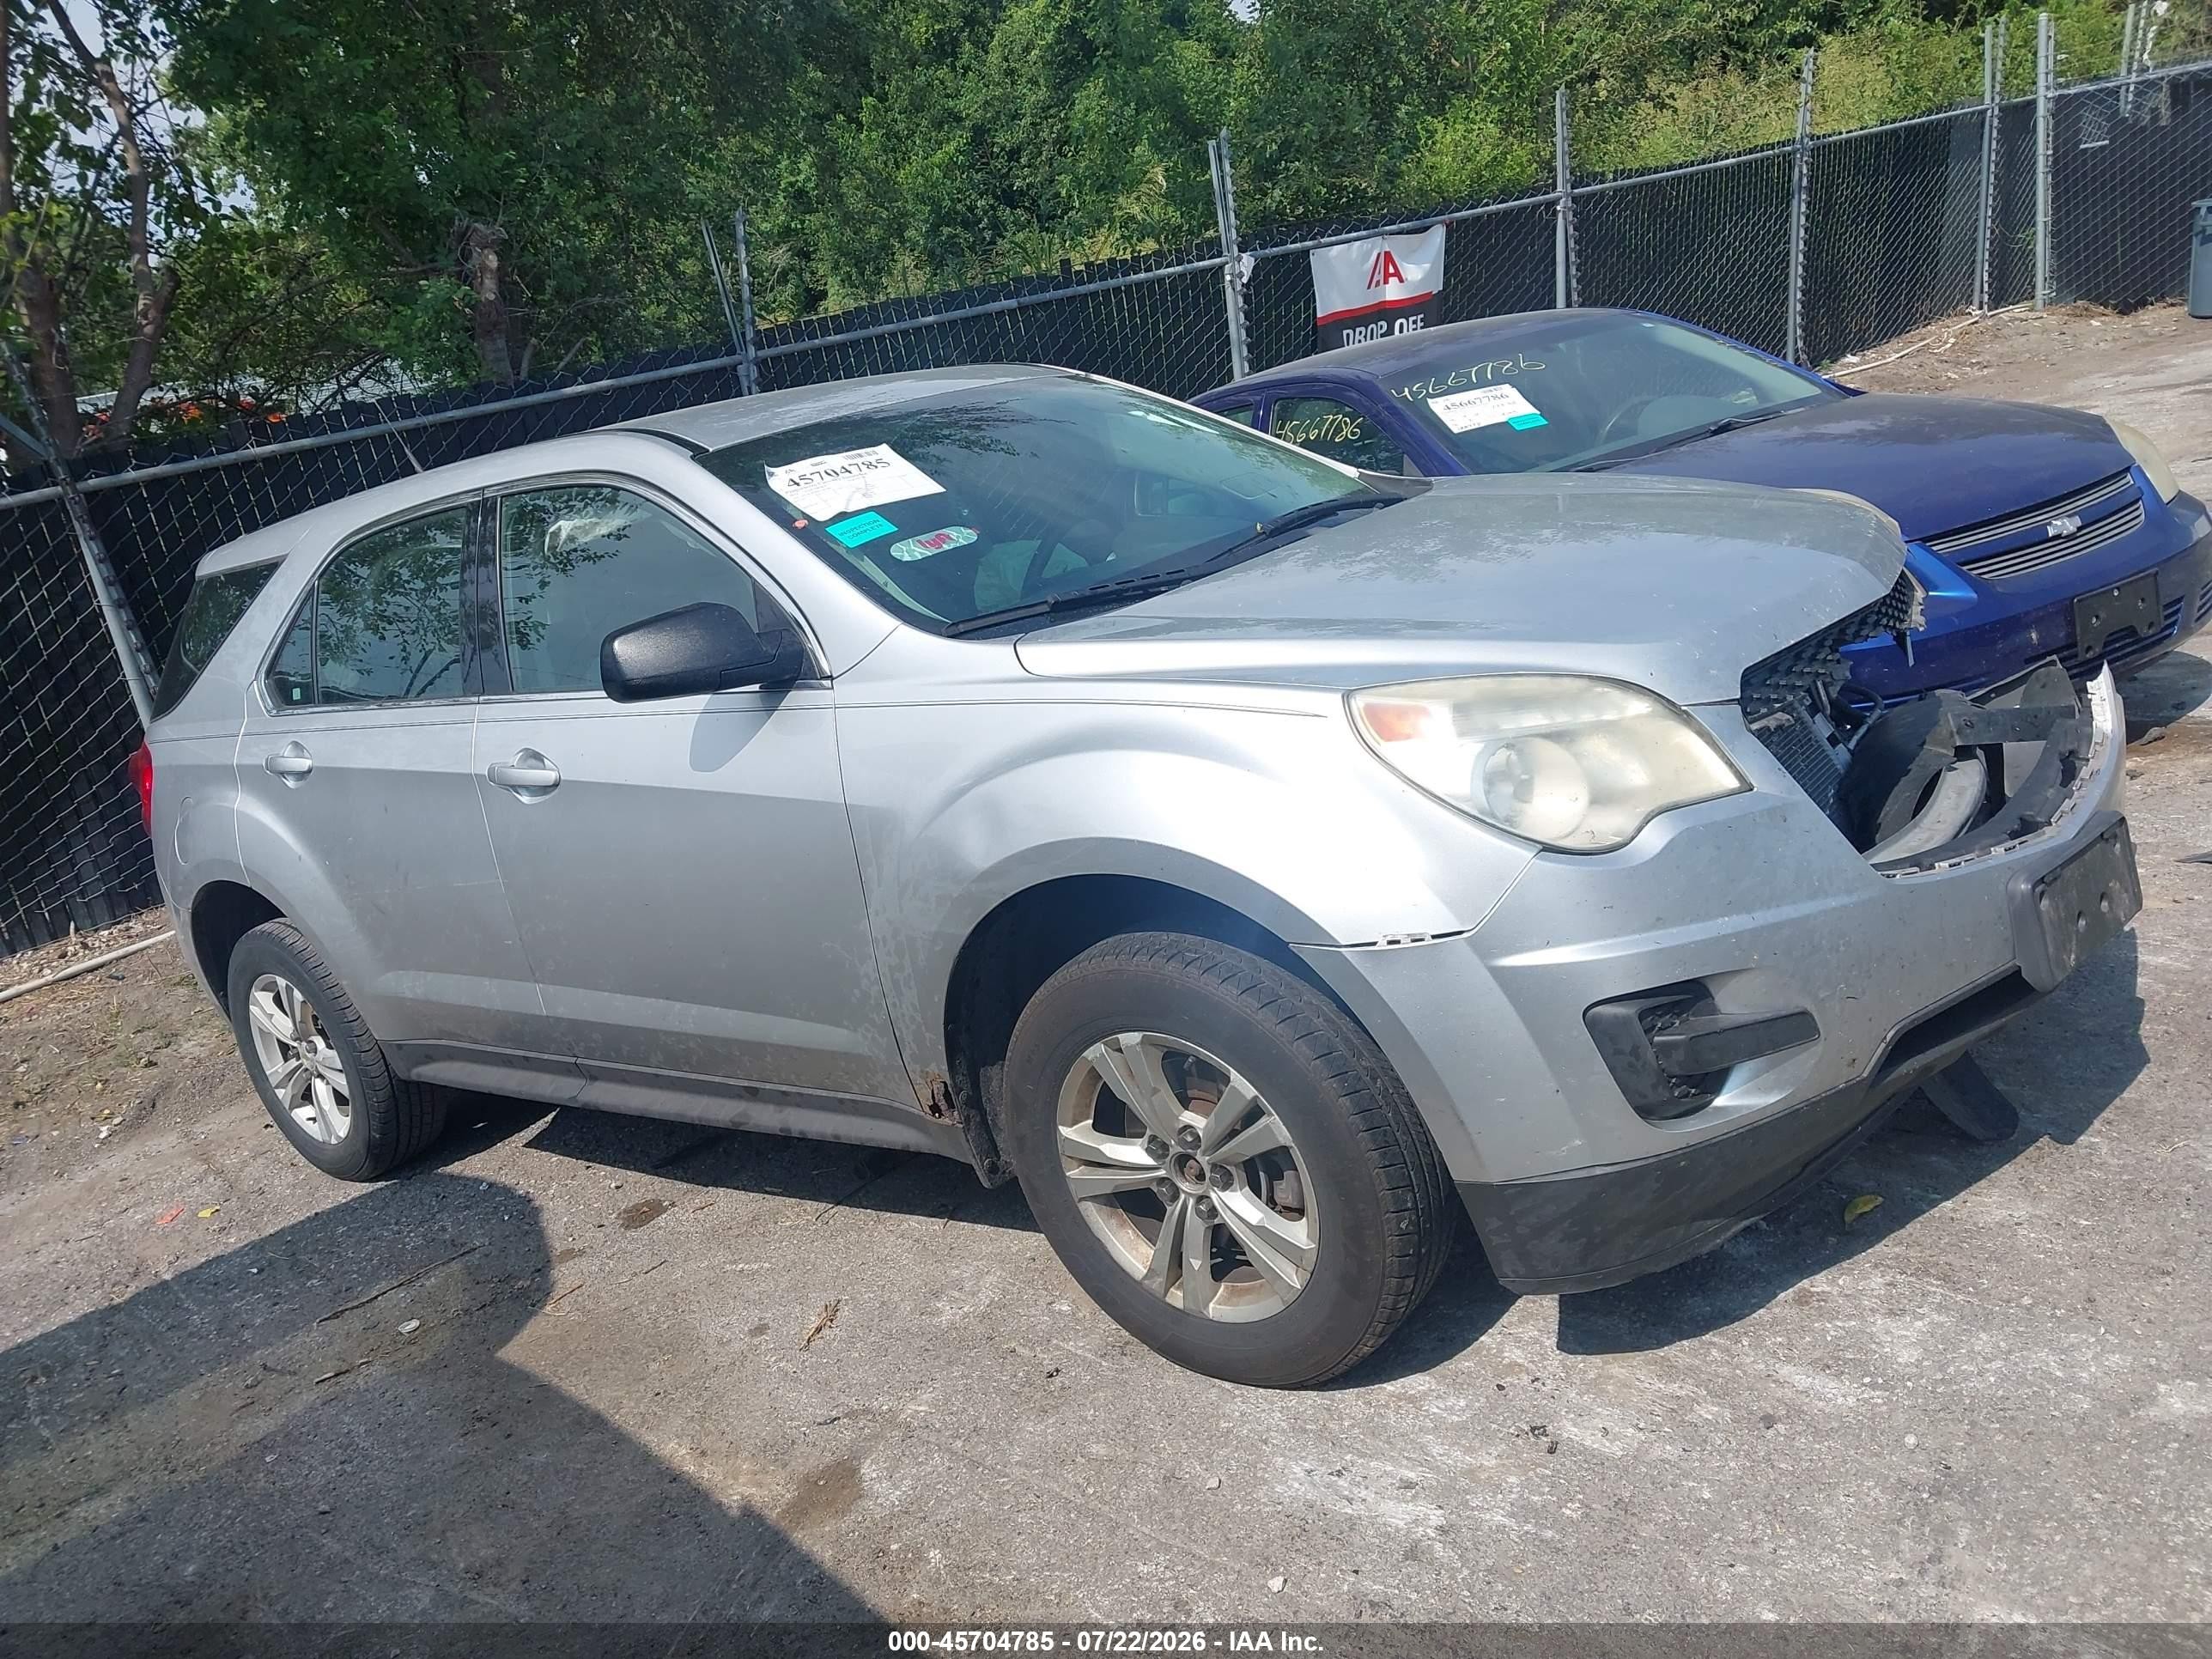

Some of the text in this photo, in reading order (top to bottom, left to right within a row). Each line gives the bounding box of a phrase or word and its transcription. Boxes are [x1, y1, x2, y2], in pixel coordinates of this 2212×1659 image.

[1342, 313, 1425, 348] DROP OFF
[1390, 353, 1547, 401] 45667786
[1275, 414, 1364, 445] 45667786
[787, 458, 891, 487] 45704785
[837, 519, 881, 538] INSPECTION
[847, 523, 884, 540] COMPLETE
